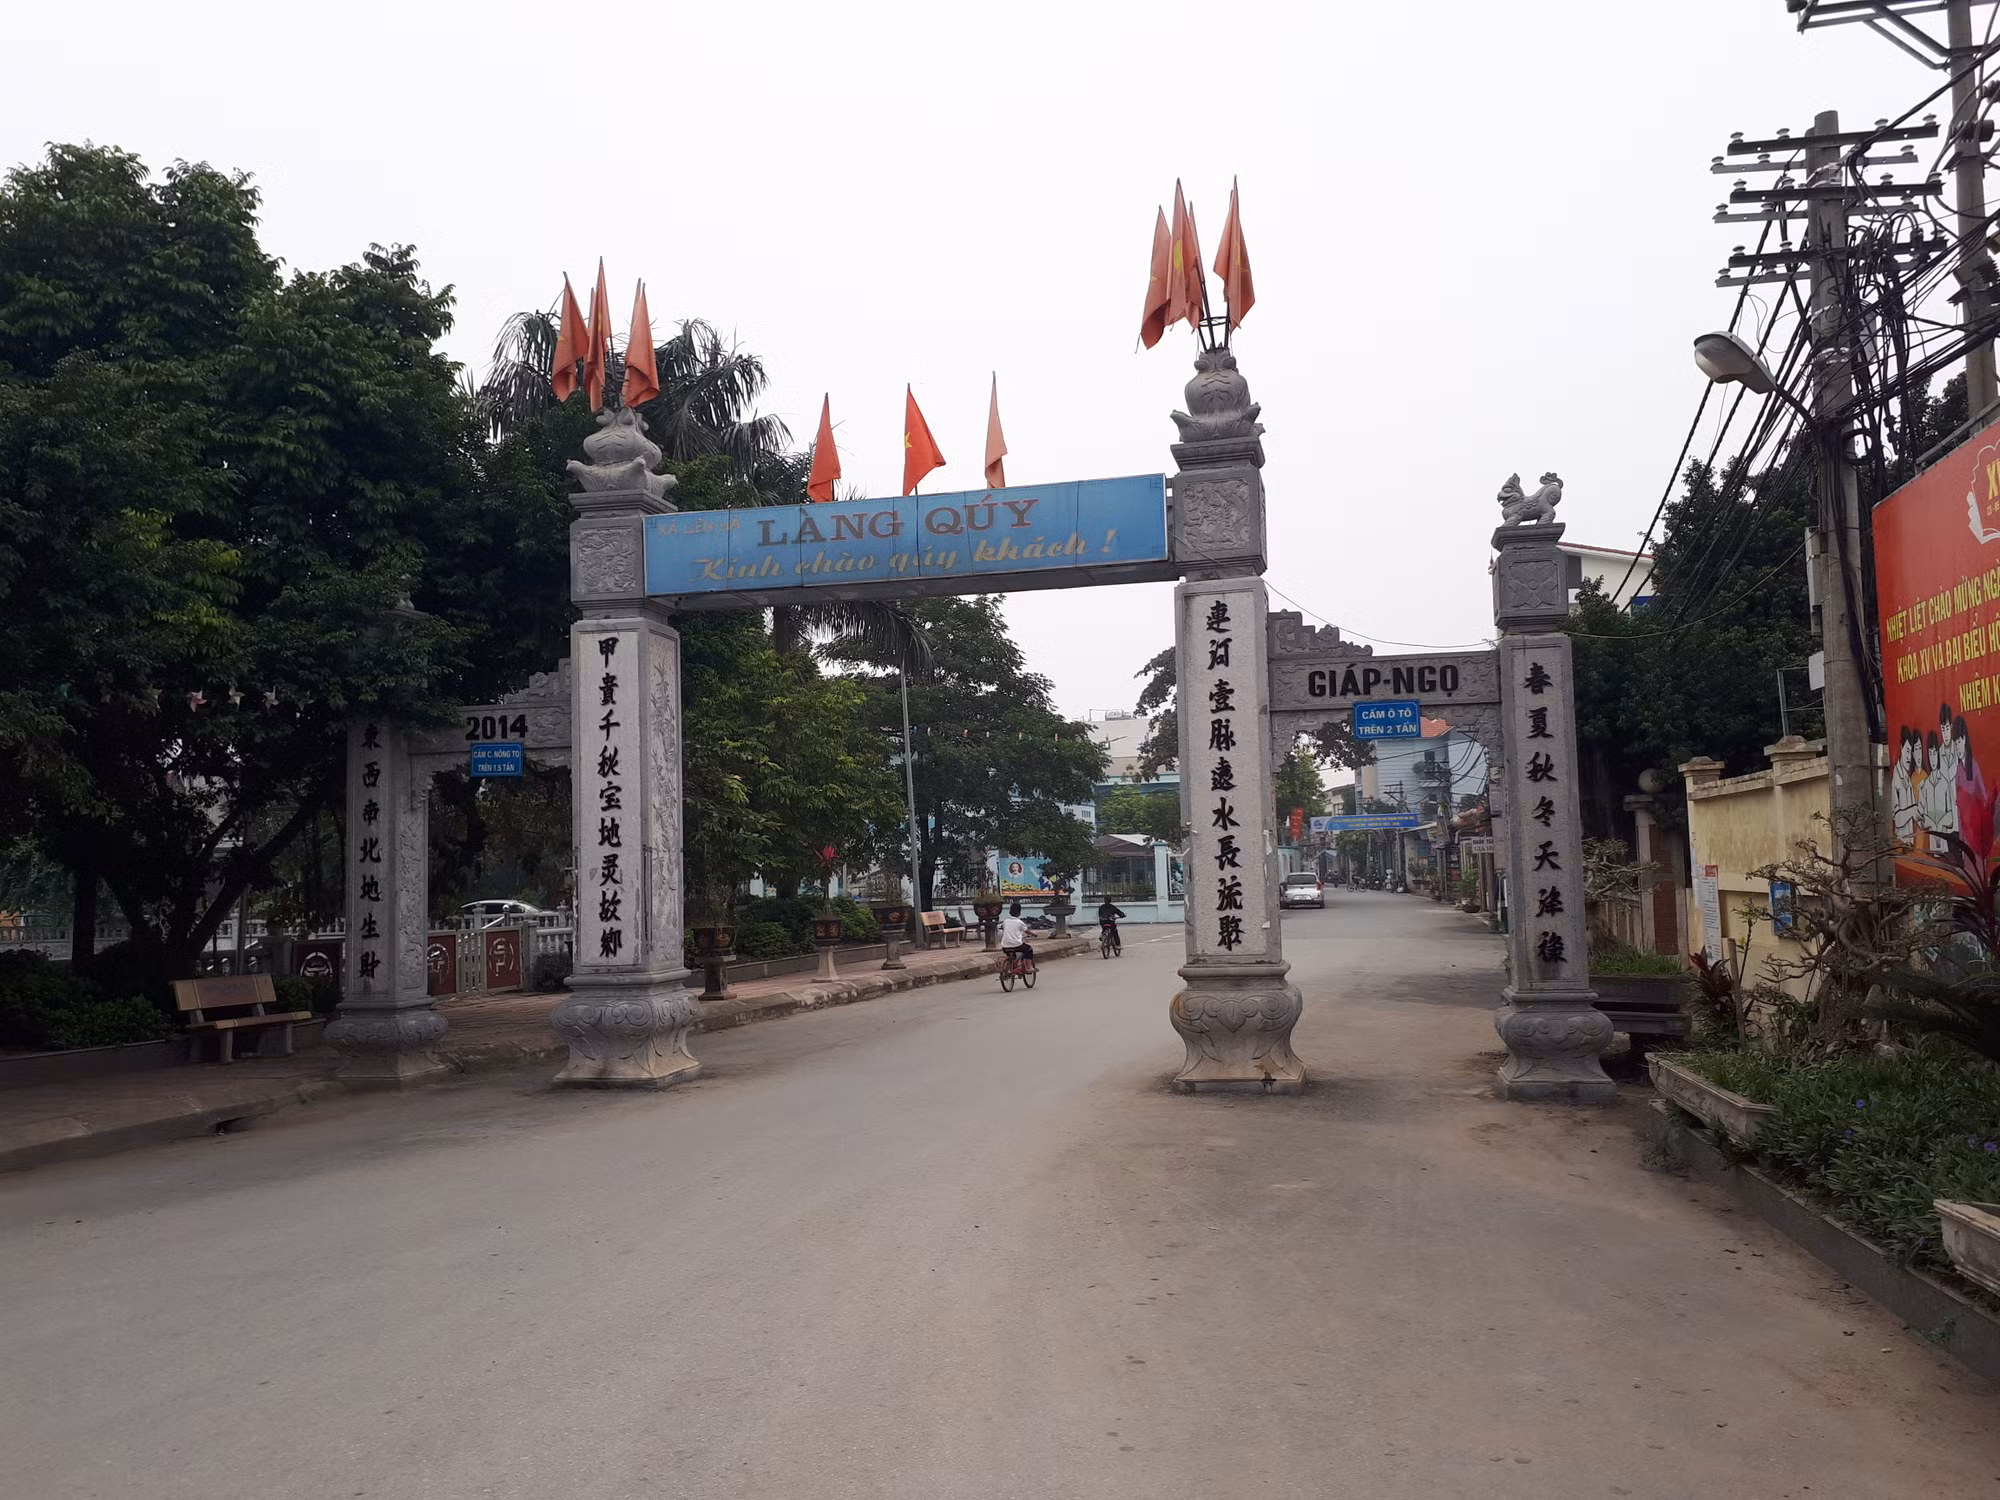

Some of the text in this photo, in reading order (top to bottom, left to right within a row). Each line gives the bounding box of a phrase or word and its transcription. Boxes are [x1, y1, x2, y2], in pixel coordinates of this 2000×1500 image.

[757, 494, 1040, 547] LÀNG QÚY
[688, 554, 784, 583] Kính
[793, 550, 875, 575] chào
[974, 531, 1088, 562] khách
[1886, 605, 1907, 644] NHIỆT
[1908, 596, 1926, 636] LIỆT
[1928, 585, 1952, 625] CHÀO
[1953, 575, 1982, 615] MỪNG
[1897, 646, 1919, 684] KHÓA
[1919, 647, 1930, 676] XV
[1931, 635, 1945, 672] VÀ
[1945, 635, 1962, 672] ĐẠI
[1962, 613, 1986, 662] BIỂU
[1308, 663, 1459, 698] GIÁP-NGỌ
[1959, 672, 1991, 715] NHIỆM
[465, 714, 528, 741] 2014
[1358, 720, 1417, 735] TRÊN 2 TẤN
[1361, 706, 1412, 720] CẤM Ô TÔ
[478, 762, 492, 772] TRÊN
[502, 761, 515, 771] TẤN
